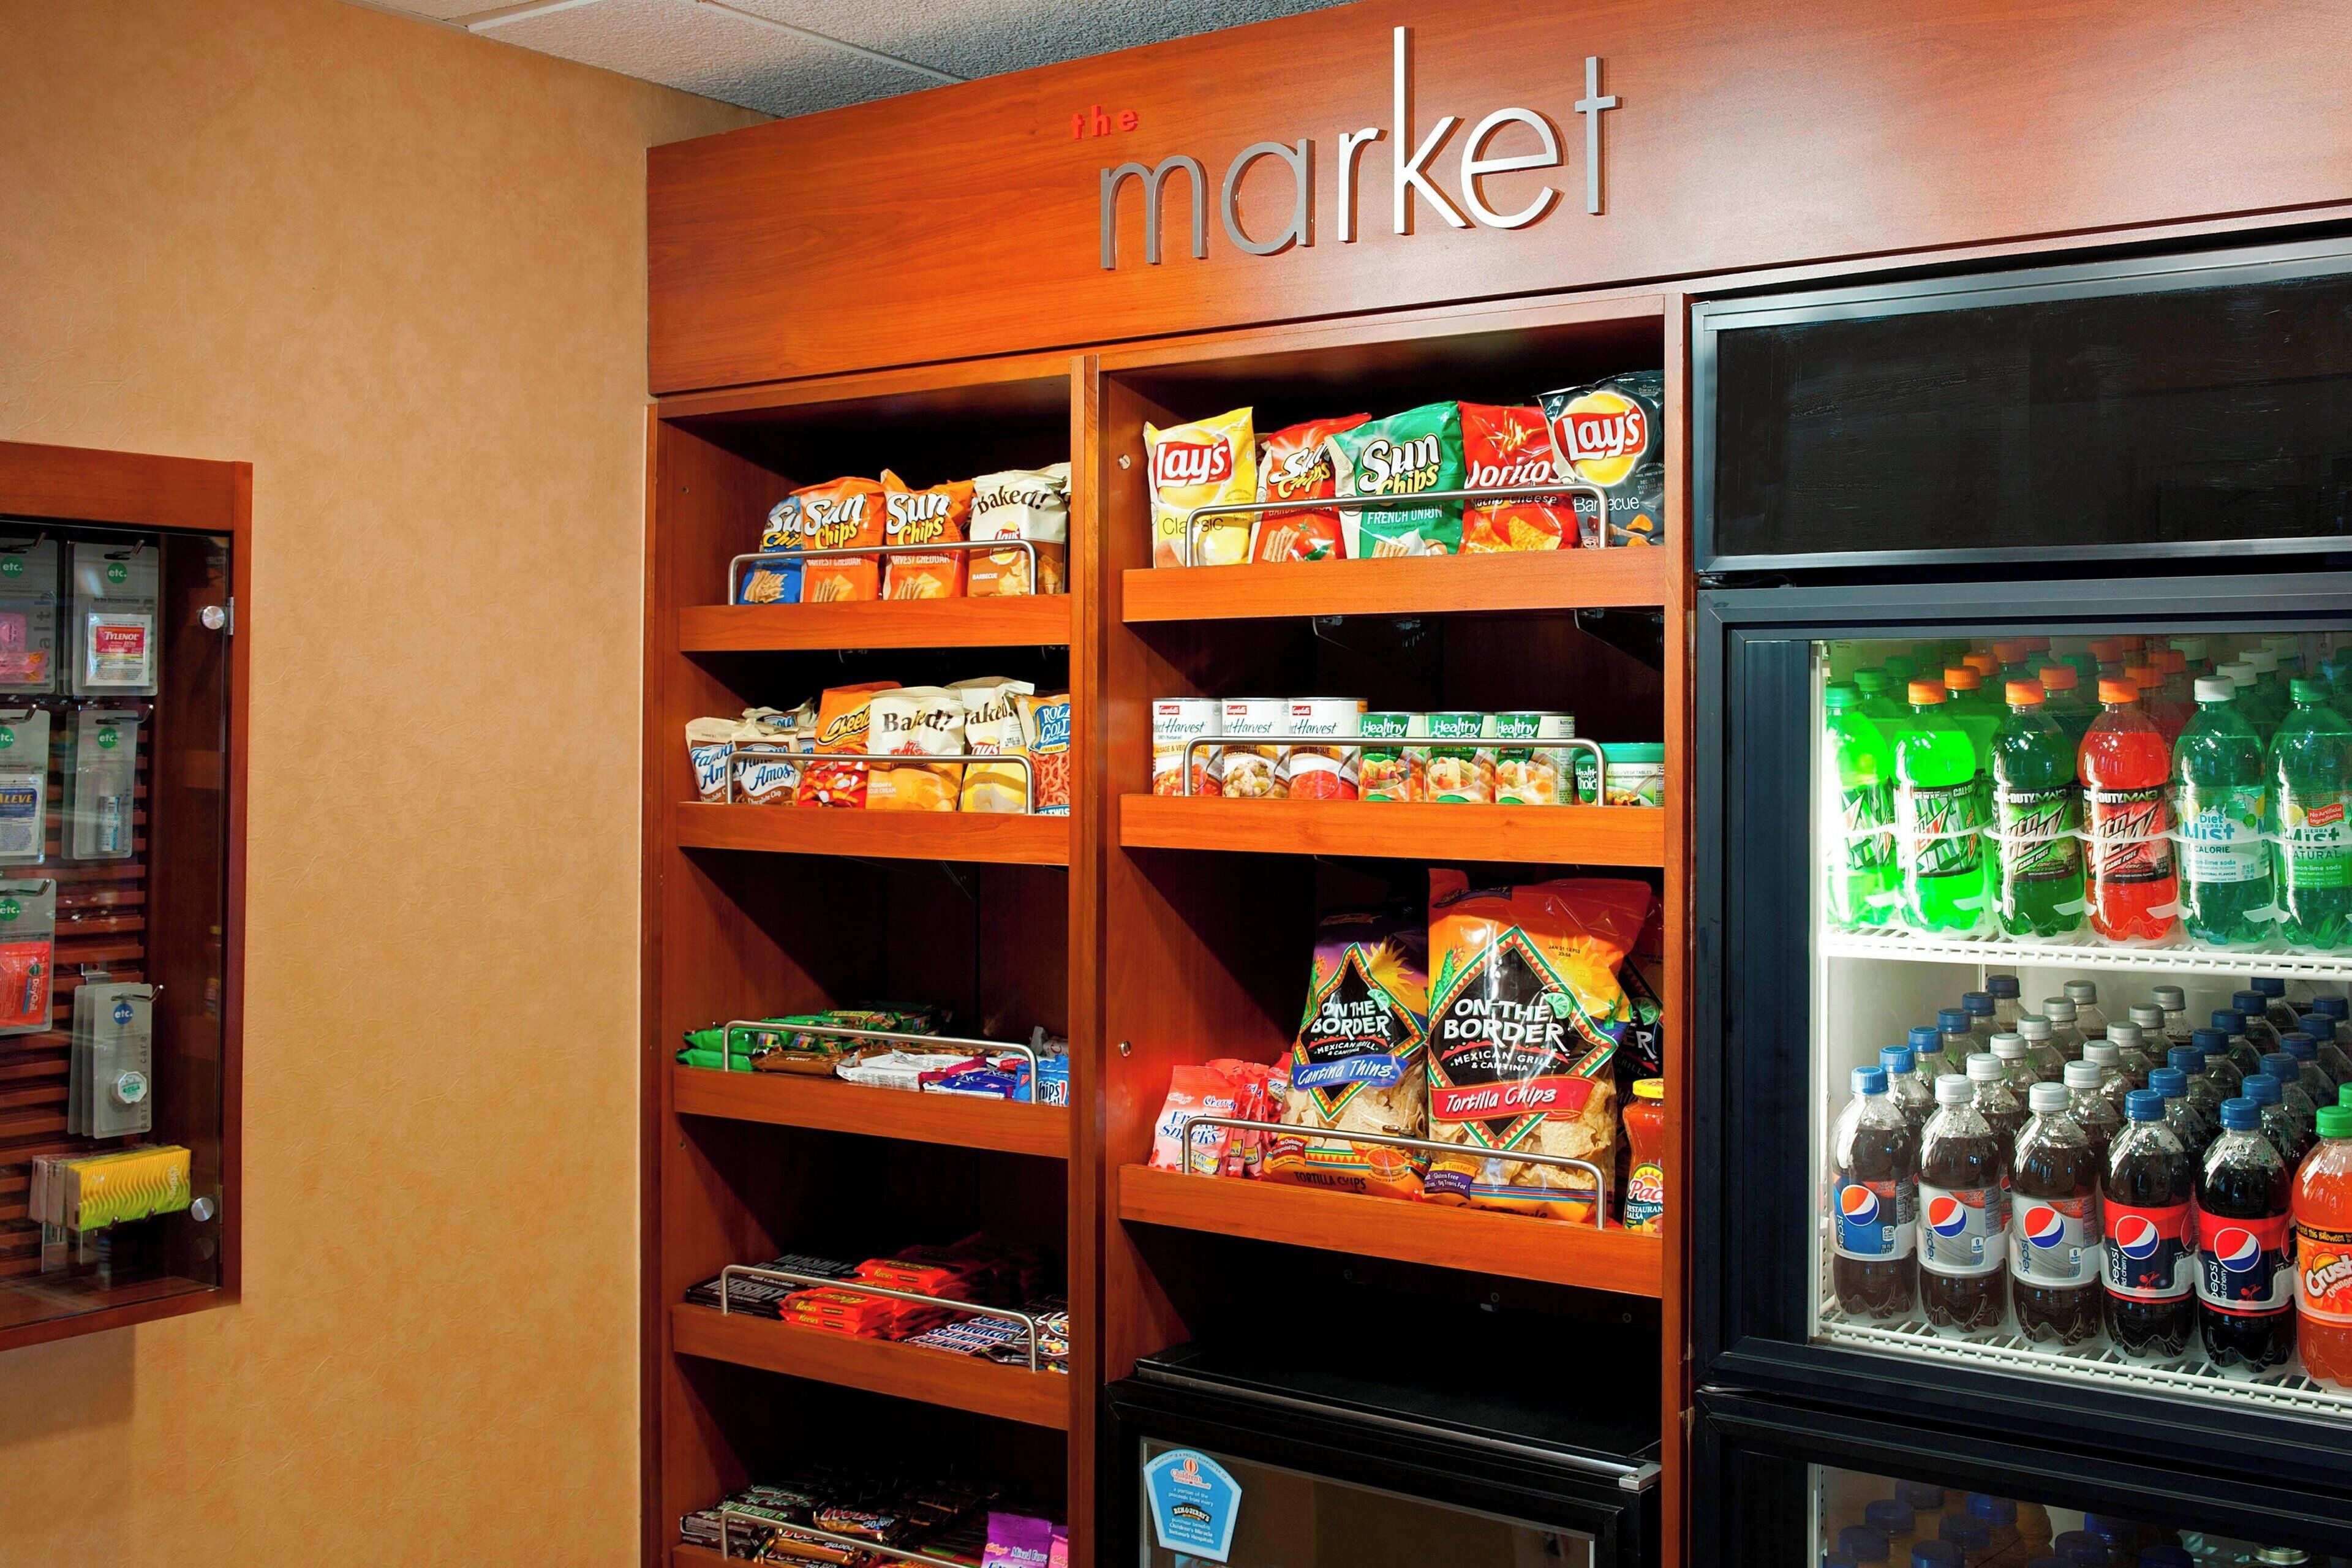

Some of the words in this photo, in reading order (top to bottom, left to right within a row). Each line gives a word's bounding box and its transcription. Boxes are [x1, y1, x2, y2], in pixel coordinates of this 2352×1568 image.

[1071, 104, 1139, 140] the
[1101, 26, 1623, 270] market
[1562, 409, 1641, 461] Lay's
[1156, 442, 1228, 488] Lay's
[1358, 434, 1442, 493] Sun
[1278, 462, 1330, 498] Chips
[886, 493, 950, 535] Sun
[1574, 496, 1640, 513] Barecue
[764, 505, 801, 533] Su
[804, 493, 866, 537] Sun
[1366, 510, 1408, 525] FRENCH
[1411, 506, 1443, 521] ONION
[815, 520, 859, 550] Chips
[897, 516, 944, 545] Chips
[763, 532, 802, 549] Chip
[2, 563, 23, 571] etc.
[891, 555, 915, 565] ARVEST
[104, 631, 139, 641] TYLENOL
[1165, 718, 1205, 733] Harvest
[1233, 718, 1273, 734] Harvest
[1296, 718, 1337, 734] Harvest
[1363, 717, 1407, 735] Healthy
[1433, 717, 1482, 736] Healthy
[1497, 717, 1538, 736] Healthy
[99, 734, 118, 742] etc.
[1308, 746, 1331, 755] BISQUE
[749, 765, 795, 791] Amos
[1576, 765, 1597, 778] Health
[2200, 815, 2223, 823] Diet
[2184, 821, 2235, 840] Mist
[2294, 851, 2341, 859] ATURAL
[115, 1009, 134, 1018] etc.
[1322, 1001, 1348, 1019] ON
[1349, 1000, 1376, 1017] THE
[1455, 998, 1493, 1016] ON
[1497, 1001, 1550, 1022] THE
[1311, 1016, 1392, 1041] BORDER
[1443, 1018, 1570, 1053] BORDER
[1317, 1041, 1356, 1055] MEXICAN
[1454, 1050, 1511, 1066] MEXICAN
[1517, 1054, 1551, 1069] GRILL
[1480, 1061, 1529, 1071] CANTINA
[1298, 1065, 1345, 1085] Cantina
[1349, 1059, 1393, 1077] Thins
[1039, 1081, 1060, 1100] hips
[1446, 1090, 1500, 1113] Tortilla
[1505, 1086, 1557, 1107] Chips
[1204, 1095, 1237, 1111] Cherry
[1159, 1123, 1219, 1145] Sncks
[1294, 1171, 1336, 1183] TORTILLA
[1628, 1180, 1664, 1203] Pac
[1627, 1205, 1664, 1213] RESTAURAN
